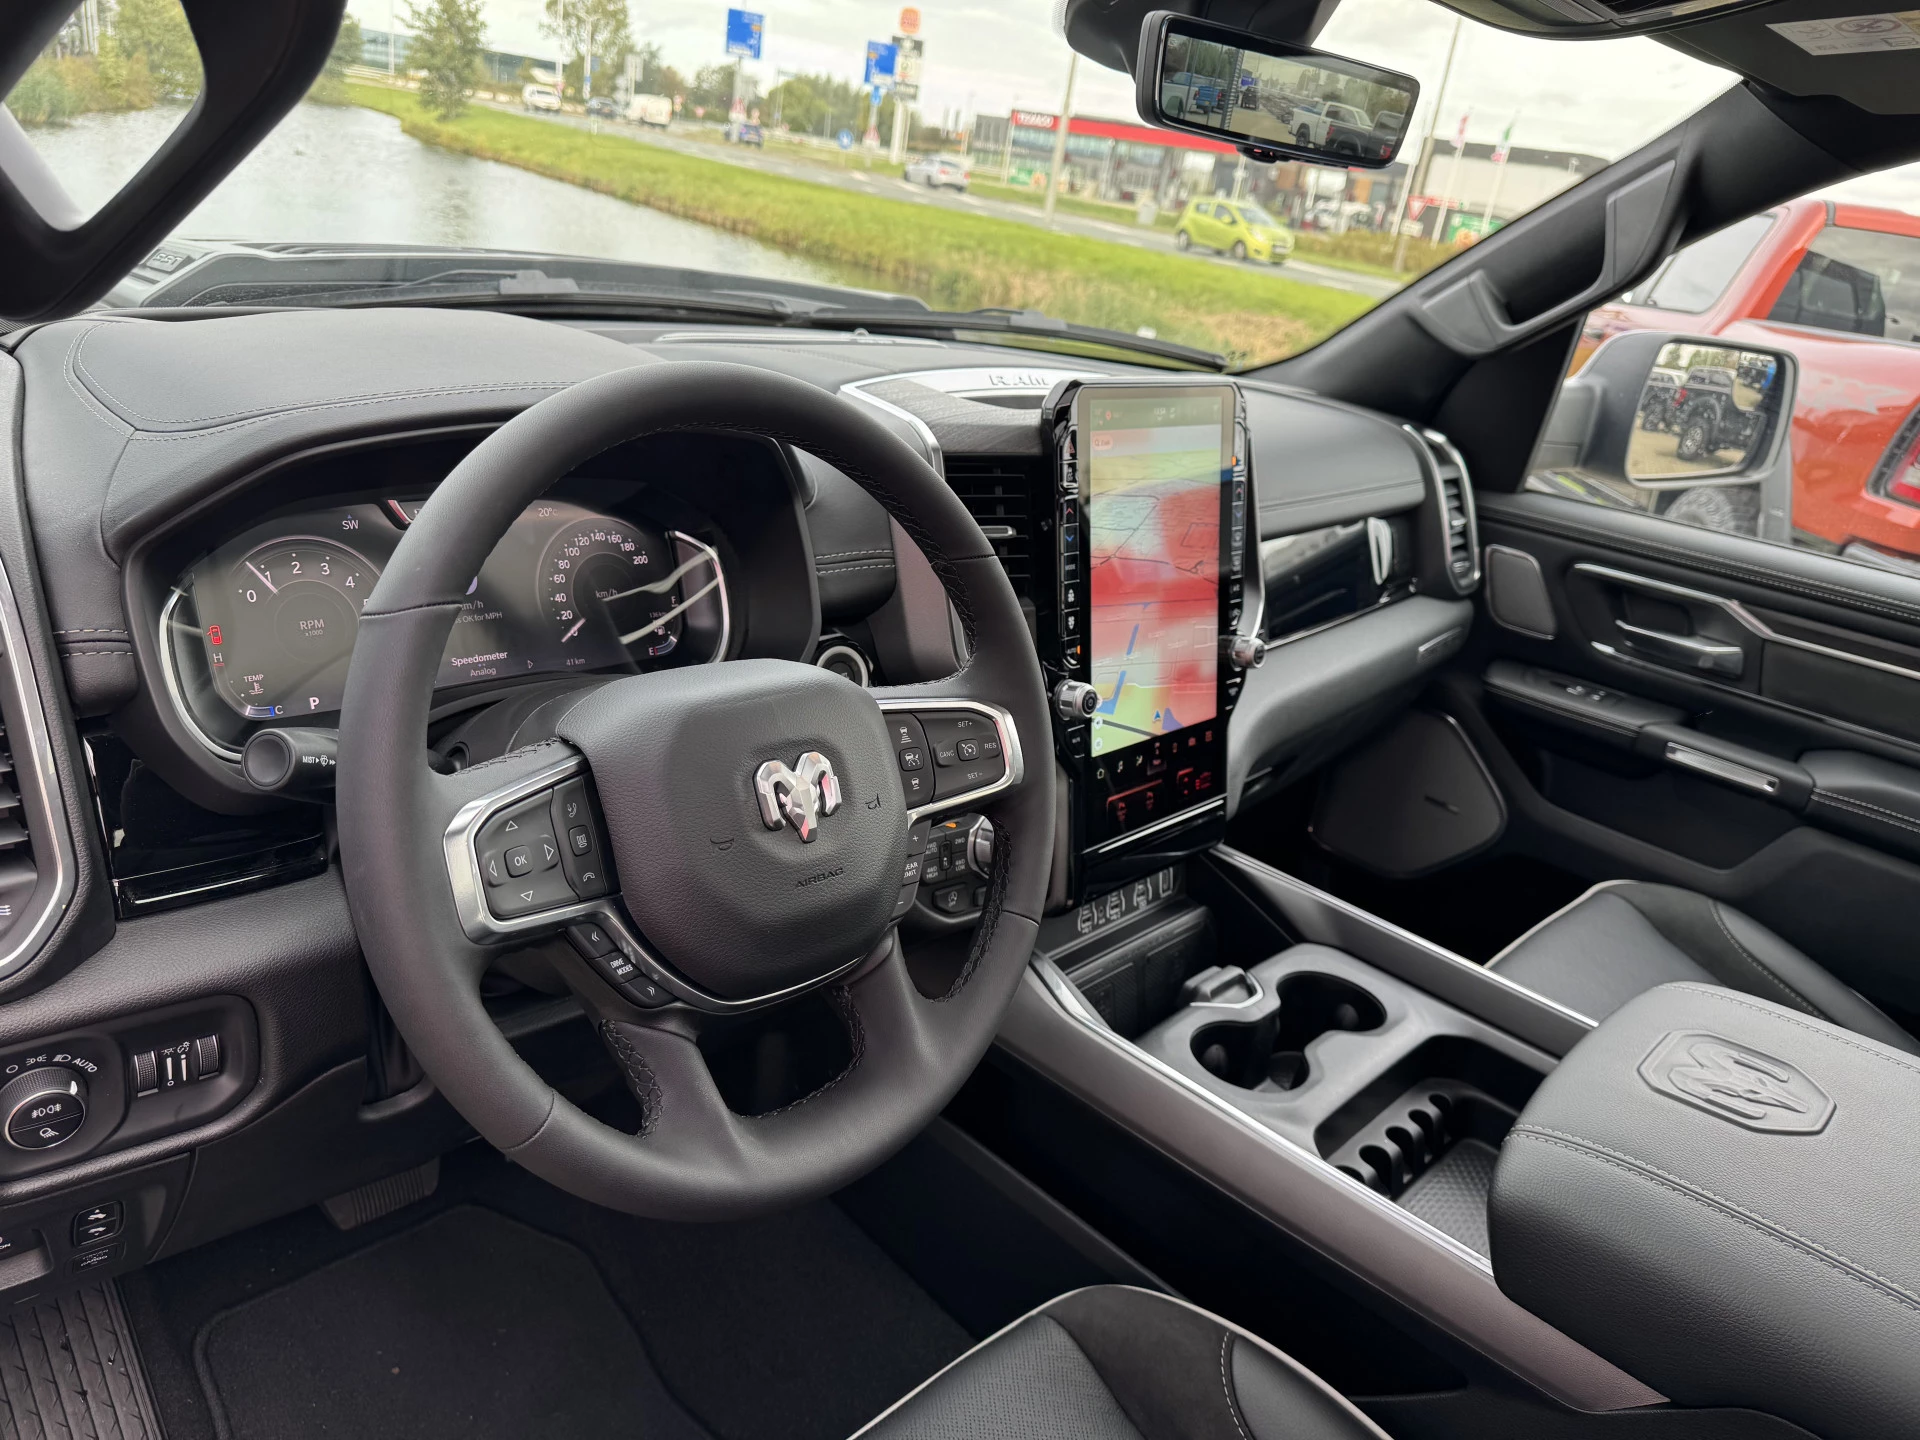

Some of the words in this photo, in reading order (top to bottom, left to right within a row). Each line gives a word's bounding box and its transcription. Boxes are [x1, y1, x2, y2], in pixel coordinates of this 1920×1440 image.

[988, 373, 1050, 386] RAM
[538, 507, 559, 517] 20°C
[342, 519, 359, 530] SW
[574, 536, 590, 546] 120
[590, 532, 606, 542] 140
[607, 534, 622, 544] 160
[564, 547, 580, 557] 100
[620, 542, 635, 552] 180
[558, 560, 570, 569] 80
[632, 555, 649, 565] 200
[291, 561, 301, 574] 2
[320, 562, 330, 575] 3
[345, 576, 355, 588] 4
[554, 574, 566, 584] 60
[246, 590, 257, 603] 0
[554, 593, 567, 603] 40
[595, 588, 618, 599] km/h
[462, 615, 475, 623] OK
[475, 613, 484, 622] for
[485, 611, 503, 621] MPH
[560, 610, 573, 620] 20
[300, 619, 325, 631] RPM
[305, 629, 323, 637] x1000
[649, 647, 654, 656] E
[213, 652, 223, 663] H
[451, 652, 508, 667] Speedometer
[575, 657, 586, 666] km
[470, 667, 497, 677] Analog
[243, 673, 264, 683] TEMP
[309, 696, 320, 709] P
[275, 705, 284, 715] C
[984, 741, 997, 750] RES
[939, 749, 955, 759] CANC
[302, 755, 315, 764] MIST
[955, 836, 966, 845] 2WD
[513, 854, 528, 868] OK
[795, 867, 845, 889] AIRBAG
[609, 956, 625, 970] DRIVE
[616, 963, 634, 976] MODES
[72, 1057, 98, 1073] AUTO
